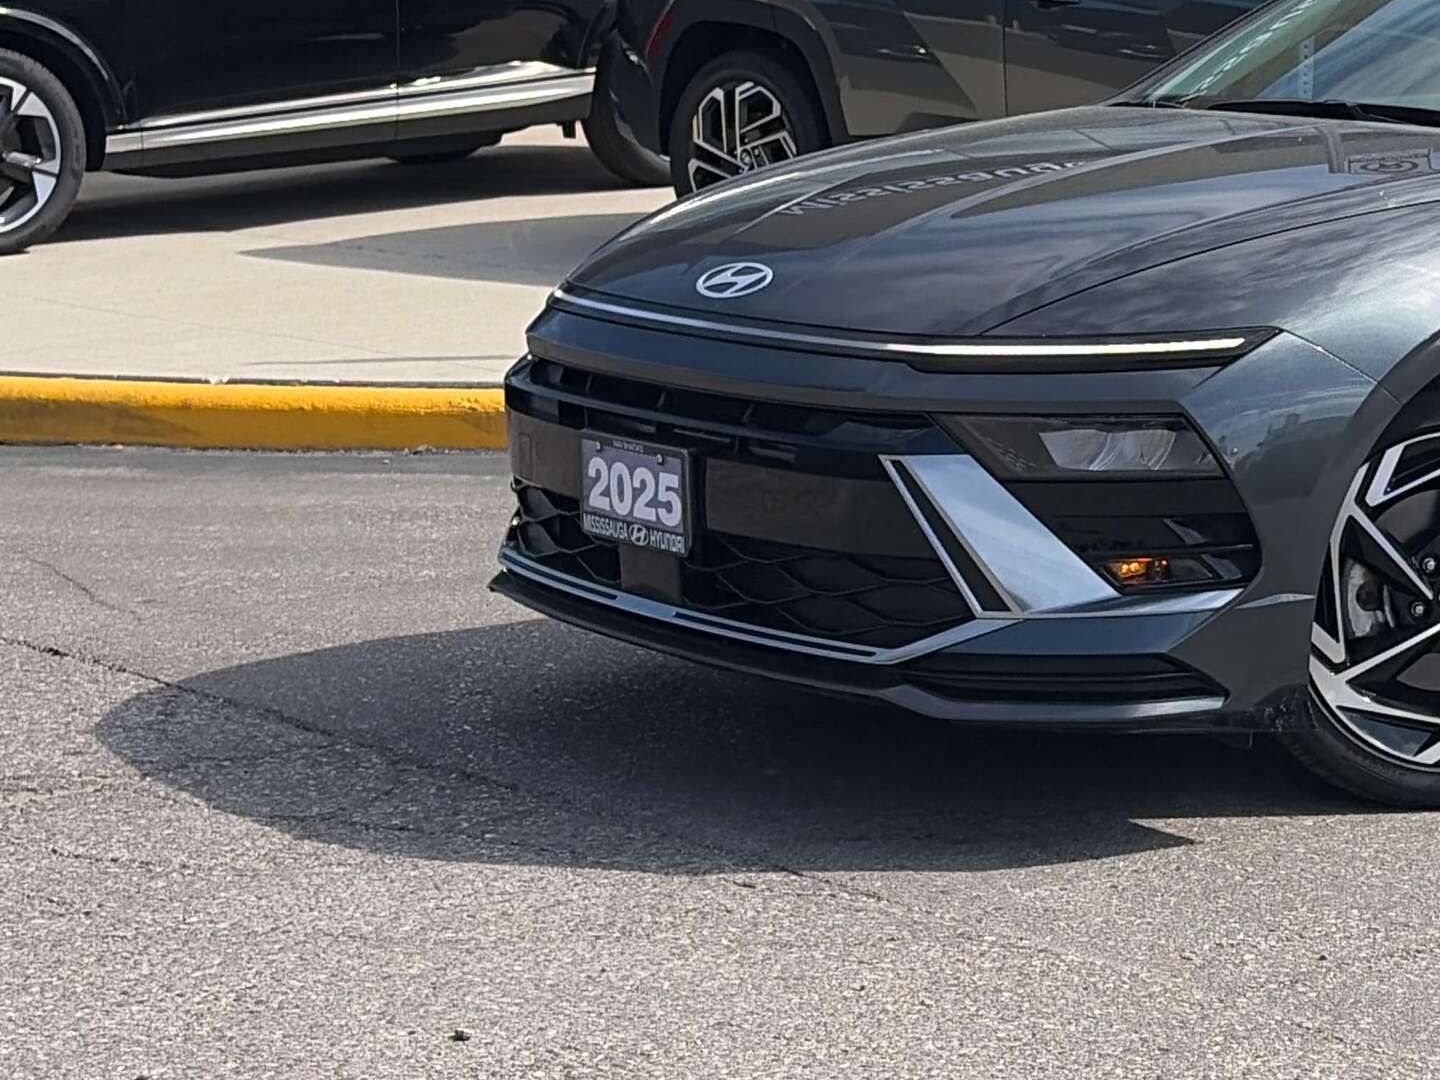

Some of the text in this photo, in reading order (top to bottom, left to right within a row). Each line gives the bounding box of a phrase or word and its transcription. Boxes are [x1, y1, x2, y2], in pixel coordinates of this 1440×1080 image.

[588, 456, 682, 527] 2025
[583, 512, 685, 554] MISSISSAUGA HYUNDAI
